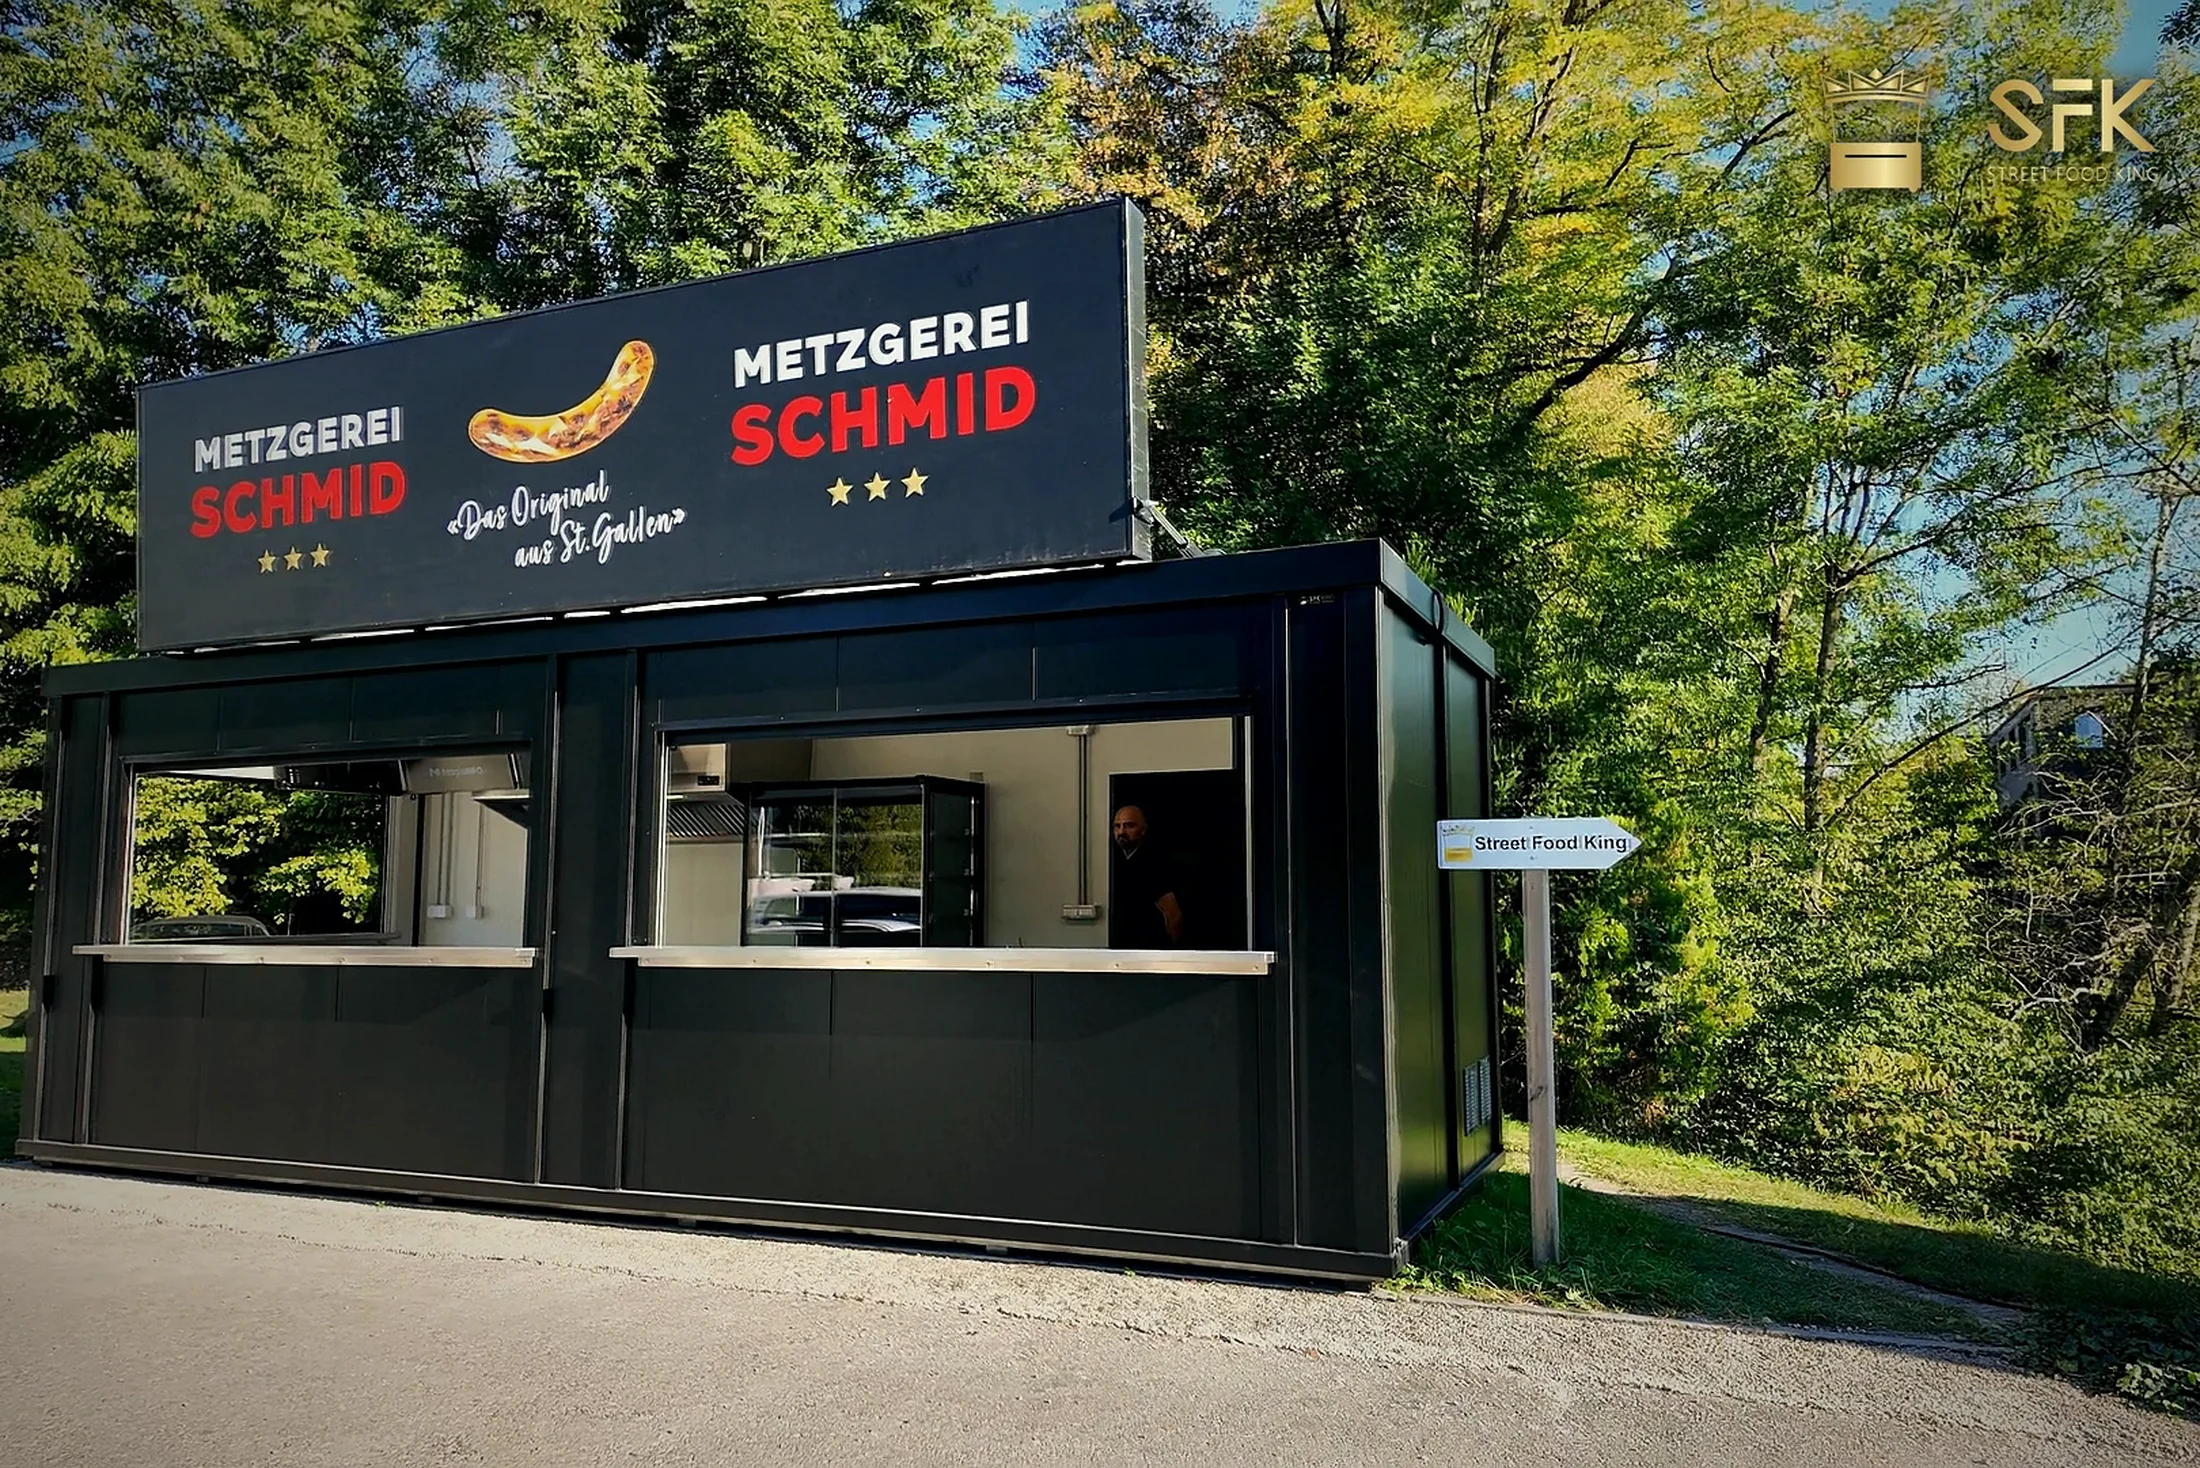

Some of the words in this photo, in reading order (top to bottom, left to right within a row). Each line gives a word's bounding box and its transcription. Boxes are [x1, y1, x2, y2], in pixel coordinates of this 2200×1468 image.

[734, 300, 1030, 389] METZGEREI
[194, 405, 404, 473] METZGEREI
[731, 366, 1036, 467] SCHMID
[190, 461, 406, 538] SCHMID
[511, 469, 610, 536] Original
[514, 539, 554, 568] aus
[1474, 836, 1528, 851] Street
[1532, 835, 1578, 851] Food
[1584, 834, 1628, 853] King
